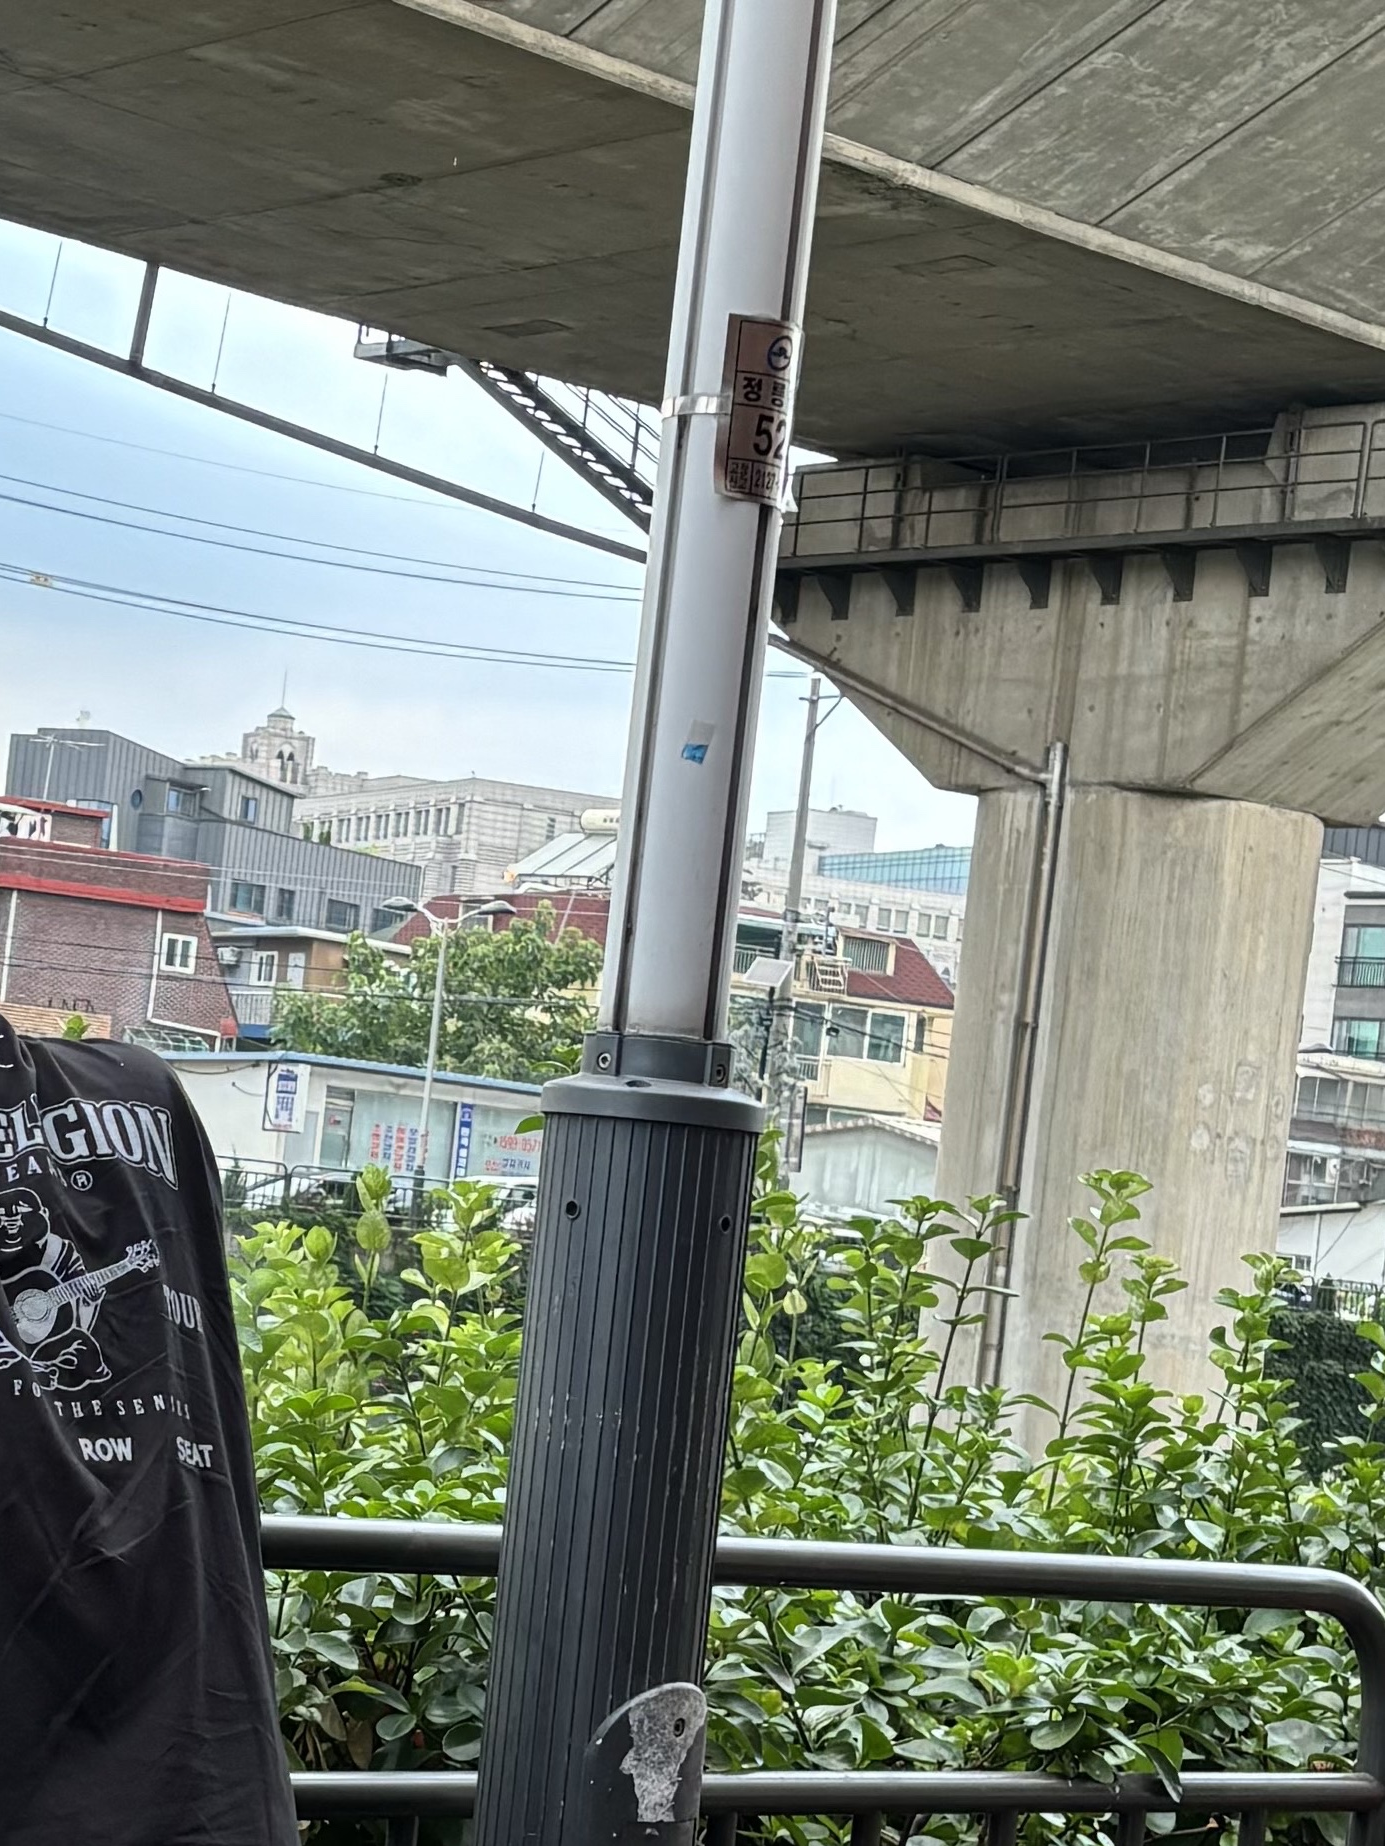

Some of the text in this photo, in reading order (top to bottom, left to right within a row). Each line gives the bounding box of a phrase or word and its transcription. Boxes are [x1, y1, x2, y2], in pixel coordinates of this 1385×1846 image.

[753, 413, 787, 460] 52
[13, 1379, 41, 1398] FO
[53, 1400, 103, 1418] THE
[78, 1436, 133, 1462] ROW
[175, 1435, 214, 1468] SEAT
